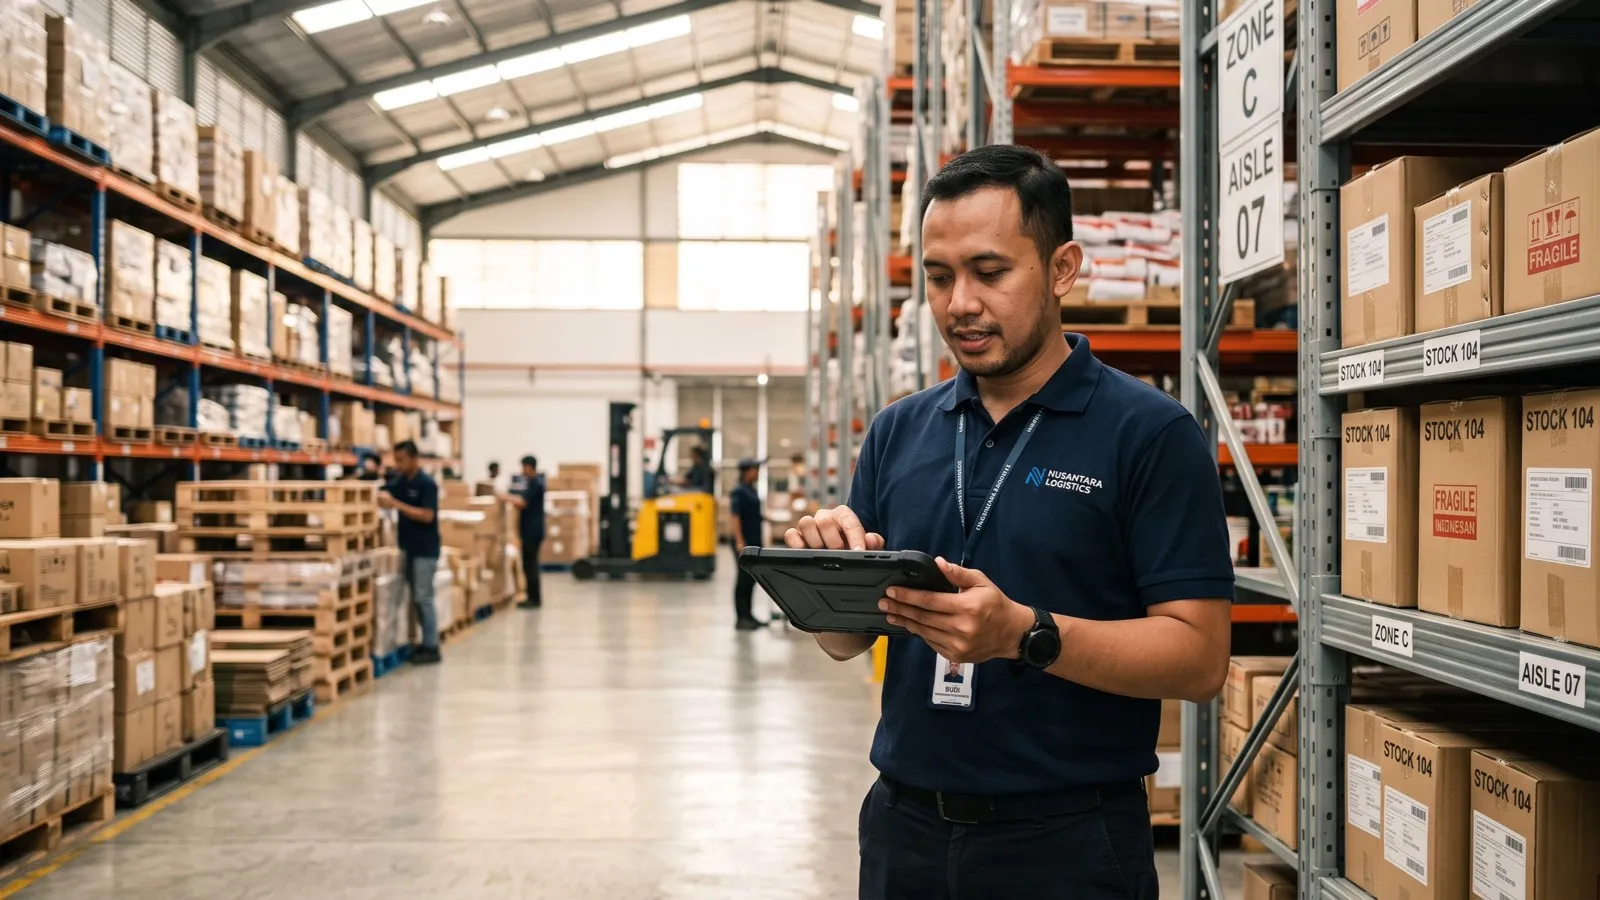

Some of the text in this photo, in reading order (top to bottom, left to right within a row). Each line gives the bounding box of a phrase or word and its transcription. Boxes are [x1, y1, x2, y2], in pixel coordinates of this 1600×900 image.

[1226, 0, 1274, 70] ZONE
[1242, 68, 1257, 119] C
[1228, 138, 1274, 195] AISLE
[1237, 195, 1265, 260] 07
[1529, 239, 1578, 270] FRAGILE
[1424, 341, 1478, 366] STOCK 104
[1340, 359, 1382, 381] STOCK 104
[1424, 417, 1485, 441] STOCK 104
[1526, 406, 1595, 432] STOCK 104
[1345, 424, 1391, 443] STOCK 104
[1045, 478, 1092, 494] LOGISTICS
[1047, 469, 1103, 489] NUSANTARA
[1435, 489, 1475, 512] FRAGILE
[1374, 623, 1409, 648] ZONE C
[945, 685, 960, 693] BUDI
[1521, 662, 1581, 696] AISLE 07
[1383, 739, 1433, 778] STOCK 104
[1474, 768, 1532, 813] STOCK 104
